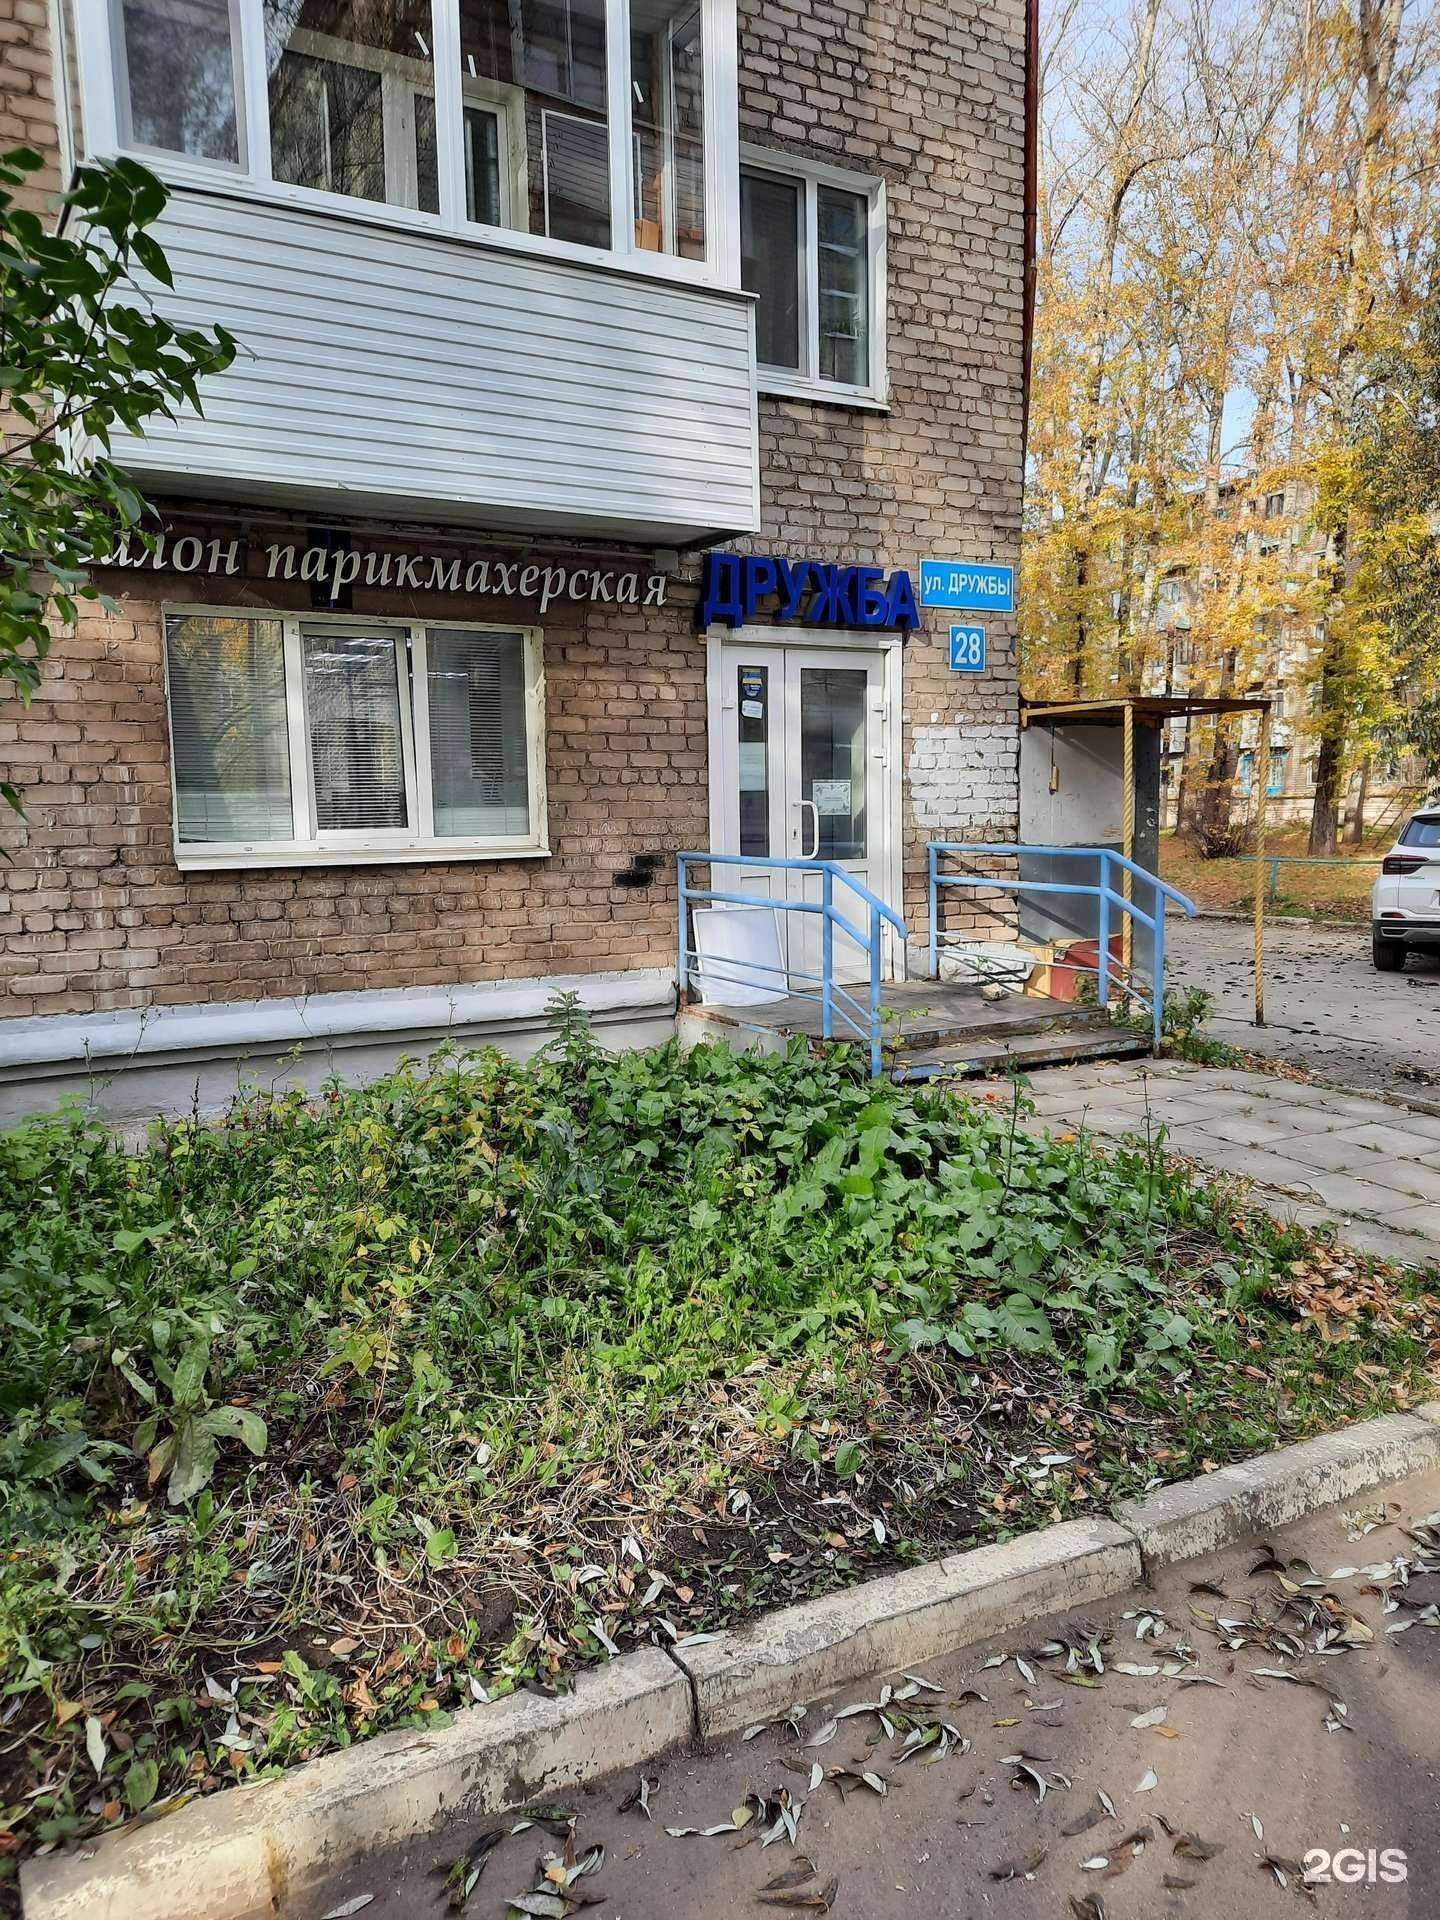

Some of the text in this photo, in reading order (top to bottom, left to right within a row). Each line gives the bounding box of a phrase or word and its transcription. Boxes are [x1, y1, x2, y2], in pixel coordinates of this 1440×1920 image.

[58, 529, 668, 613] алон парикмахерская
[702, 553, 920, 628] ДРУЖБА
[924, 573, 1010, 596] ул. ДРУЖБЫ
[954, 632, 981, 664] 28
